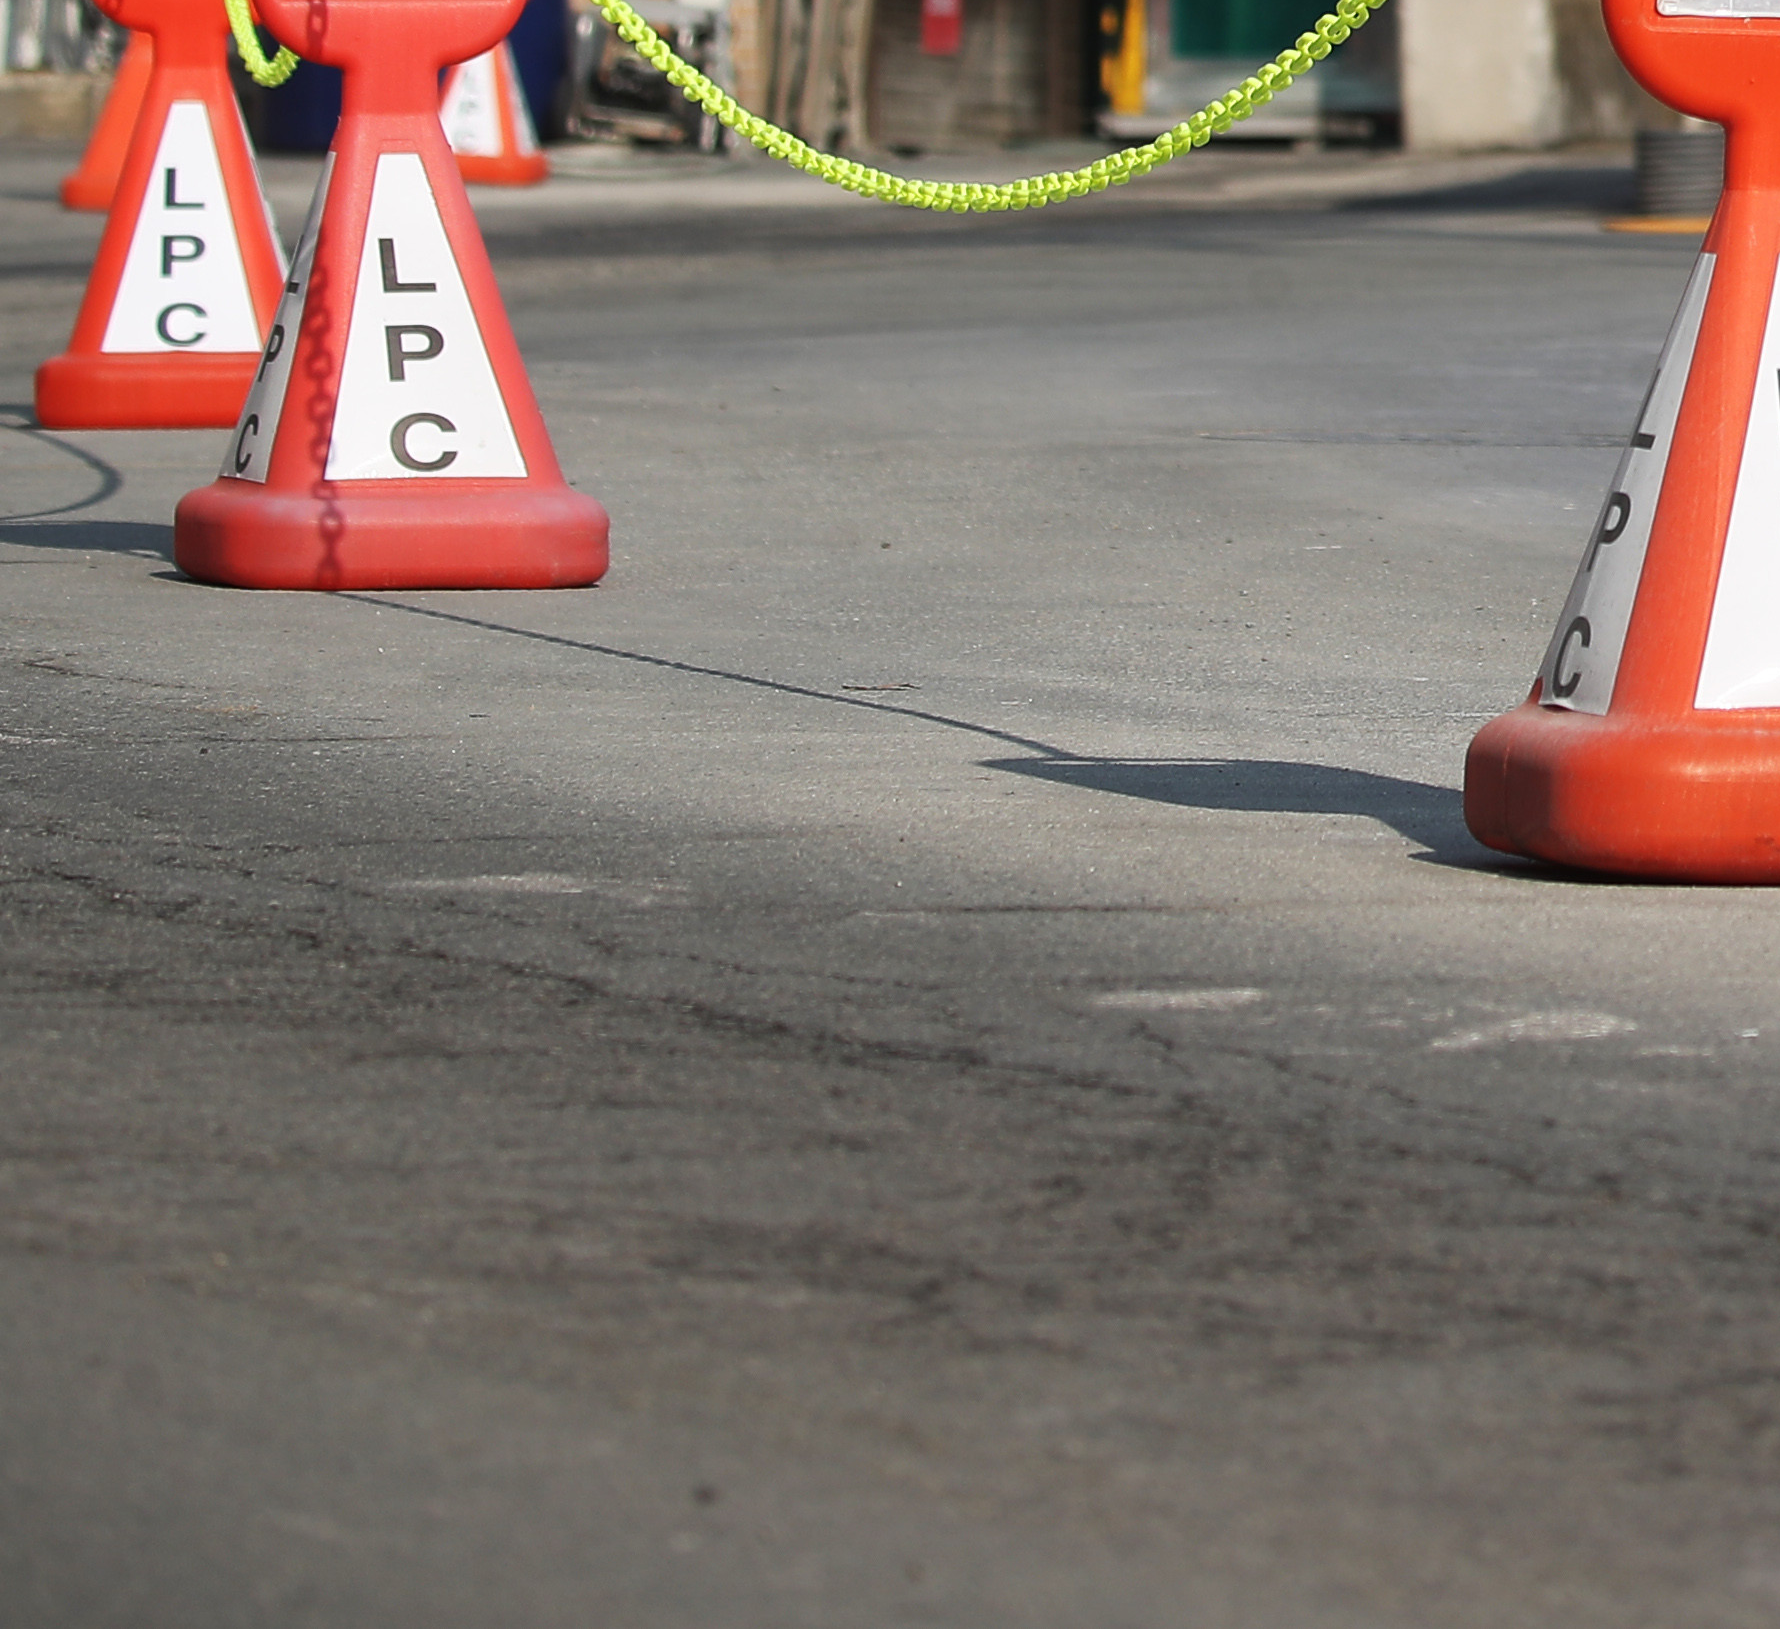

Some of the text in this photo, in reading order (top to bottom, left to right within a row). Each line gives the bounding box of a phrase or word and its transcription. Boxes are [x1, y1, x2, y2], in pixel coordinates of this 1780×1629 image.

[157, 167, 208, 347] LPC
[378, 237, 458, 472] LPC
[1551, 368, 1660, 699] LPC
